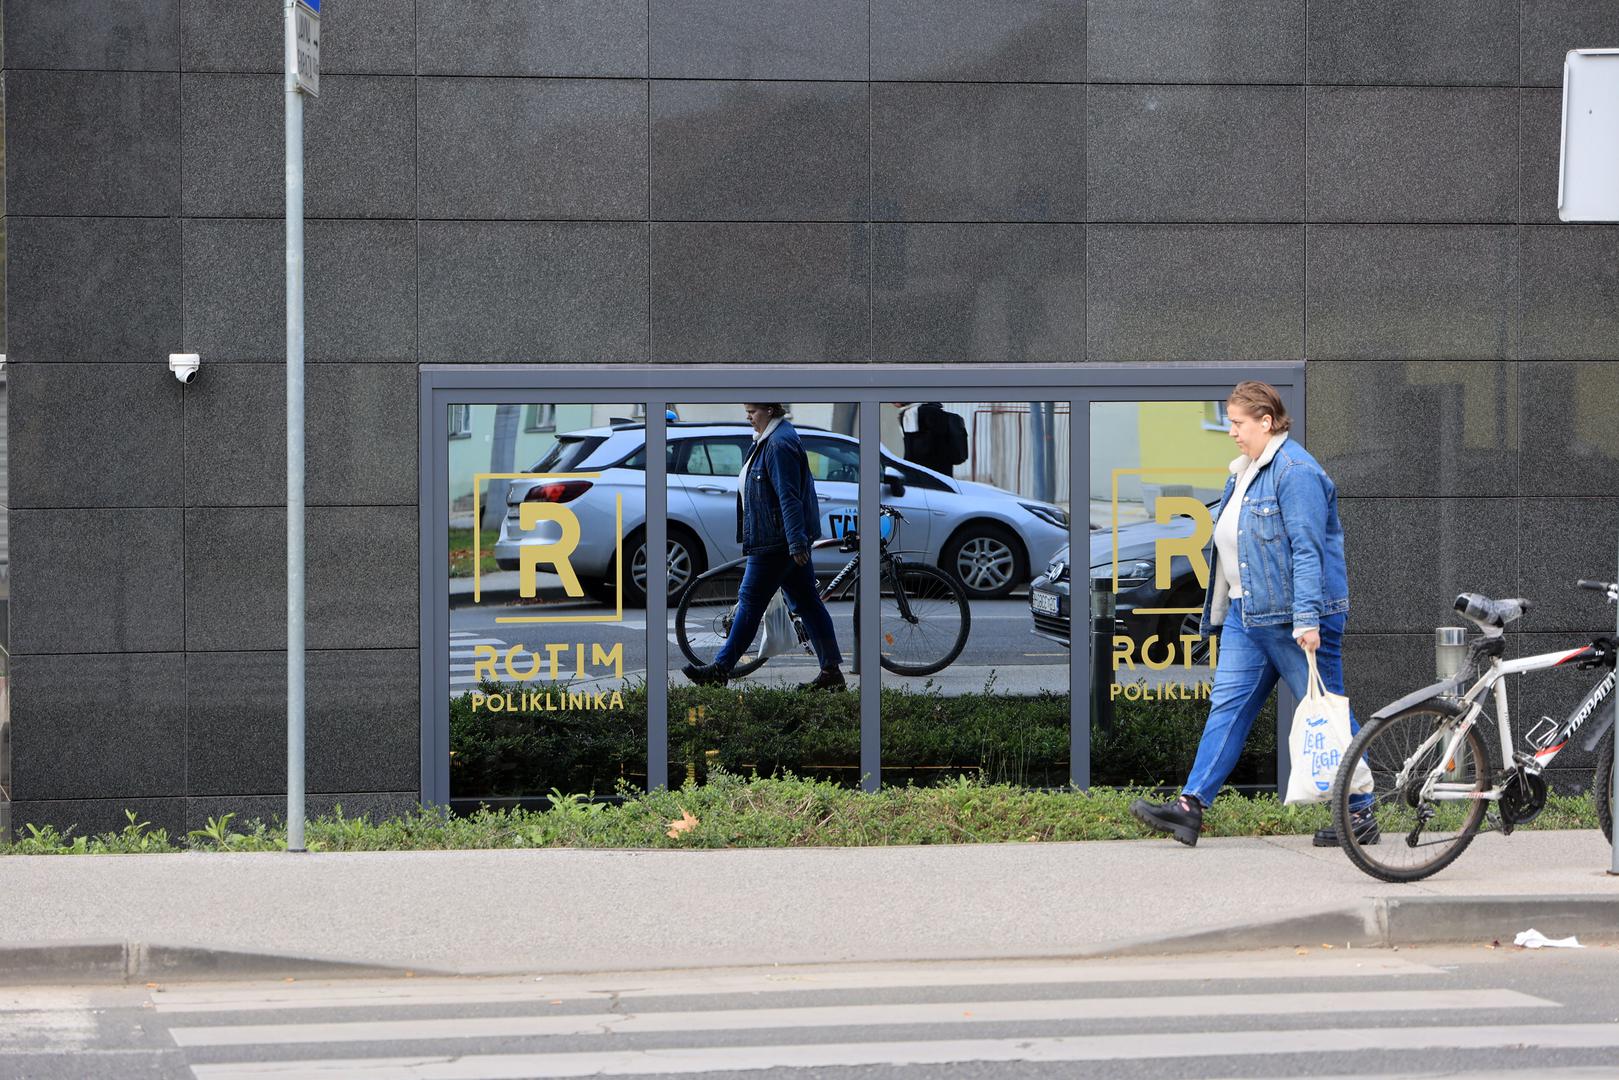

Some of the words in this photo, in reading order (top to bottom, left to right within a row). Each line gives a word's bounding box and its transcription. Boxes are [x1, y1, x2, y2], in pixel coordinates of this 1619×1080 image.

[520, 502, 584, 597] R
[1156, 496, 1212, 590] R
[474, 643, 623, 681] ROTIM
[1112, 634, 1217, 671] ROTI
[471, 692, 624, 712] POLIKLINIKA
[1110, 682, 1212, 701] POLIKLIN
